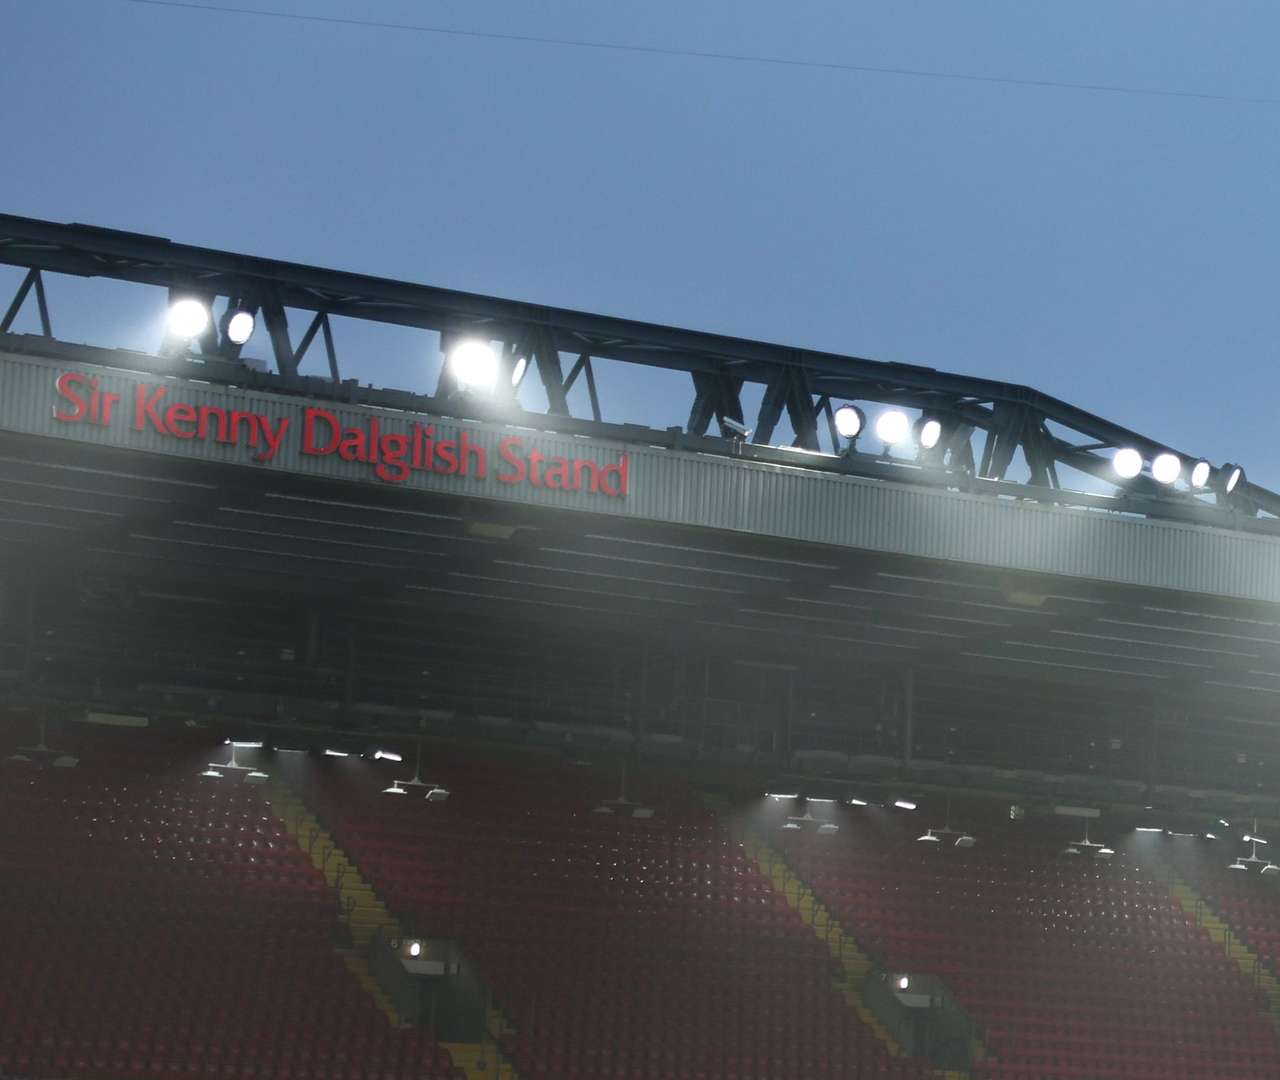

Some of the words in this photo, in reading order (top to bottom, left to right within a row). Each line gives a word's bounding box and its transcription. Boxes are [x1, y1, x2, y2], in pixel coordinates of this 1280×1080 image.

[53, 372, 120, 425] Sir
[135, 383, 290, 463] Kenny
[301, 405, 487, 483] Dalglish
[499, 436, 630, 499] Stand
